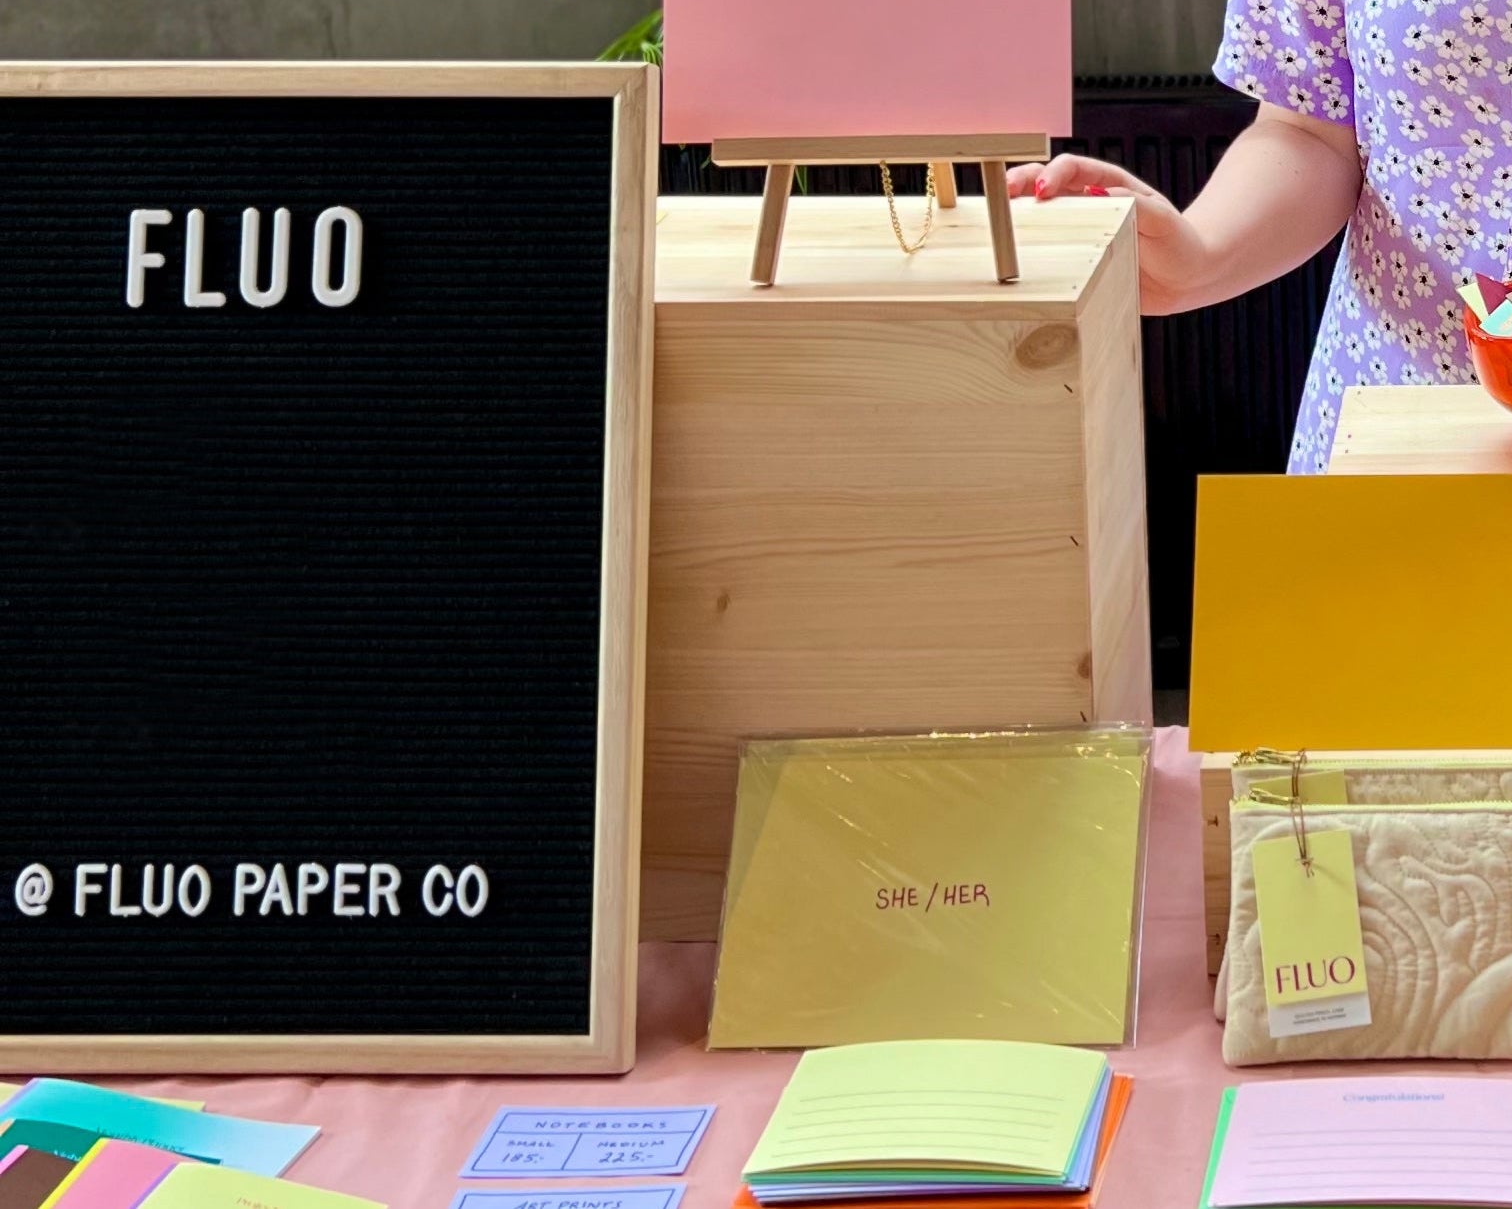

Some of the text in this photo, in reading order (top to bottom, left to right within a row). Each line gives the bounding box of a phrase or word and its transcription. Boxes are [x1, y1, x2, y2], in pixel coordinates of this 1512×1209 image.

[126, 205, 364, 308] FLUO
[14, 862, 490, 918] @ FLUO PAPER CO
[1275, 955, 1356, 994] FLUO
[506, 1139, 665, 1149] SMALL MEDIUM
[534, 1120, 668, 1130] NOTEBOOKS
